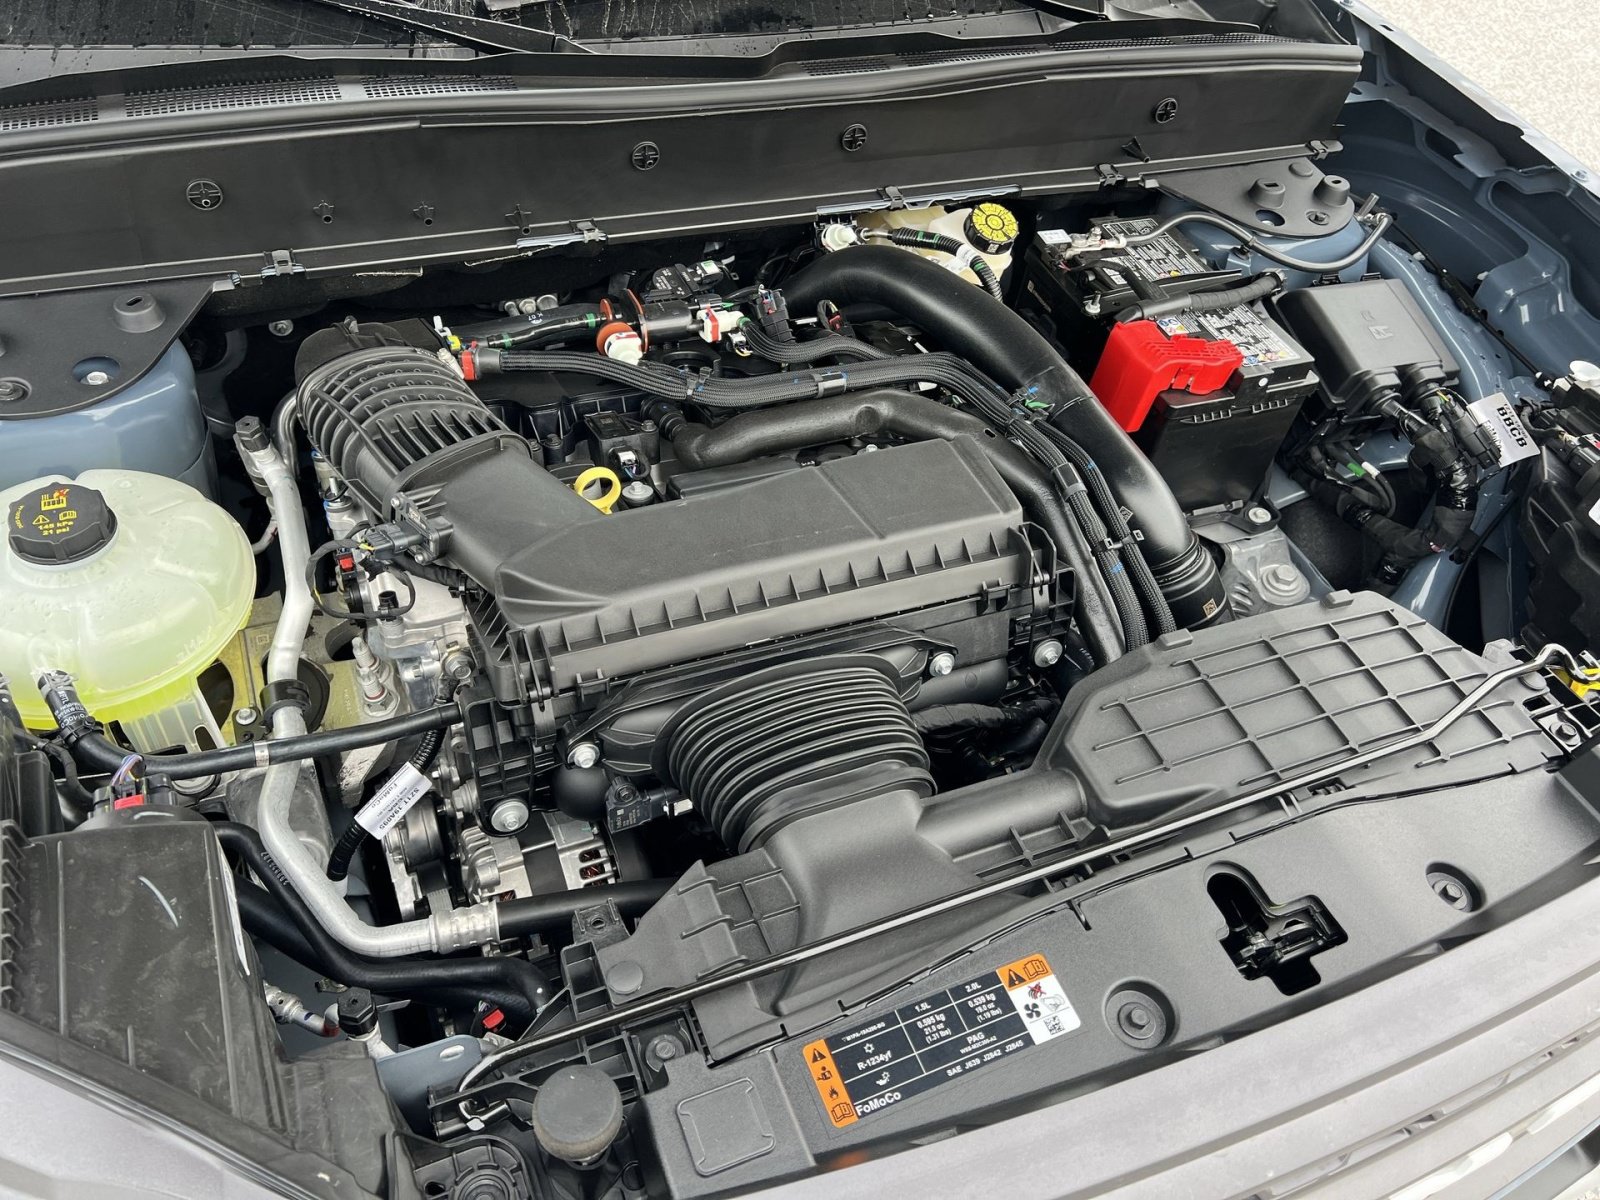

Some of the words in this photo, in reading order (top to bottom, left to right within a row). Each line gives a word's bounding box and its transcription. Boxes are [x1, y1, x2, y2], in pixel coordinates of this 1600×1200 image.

[1496, 406, 1528, 447] BBCB
[38, 522, 55, 531] 145
[56, 520, 74, 528] kPa
[42, 528, 54, 536] 21
[55, 526, 70, 535] psi
[964, 981, 982, 993] 2.0L
[914, 1001, 932, 1013] 1.5L
[967, 995, 986, 1009] 0.539
[984, 993, 997, 1002] kg
[974, 1004, 987, 1014] 19.0
[987, 1002, 996, 1010] oz
[916, 1015, 936, 1029] 0.595
[934, 1013, 946, 1022] kg
[976, 1011, 991, 1023] (1.19
[989, 1007, 1003, 1017] lbs)
[923, 1025, 937, 1036] 21.0
[936, 1022, 945, 1030] oz
[925, 1031, 940, 1045] (1.31
[938, 1027, 952, 1038] lbs)
[966, 1031, 985, 1045] PAG
[856, 1050, 893, 1071] R-1234yf
[946, 1065, 964, 1077] SAE
[964, 1058, 981, 1070] J639
[982, 1048, 1003, 1062] J2842
[1004, 1039, 1025, 1053] J2845
[854, 1091, 902, 1117] FoMoCo
